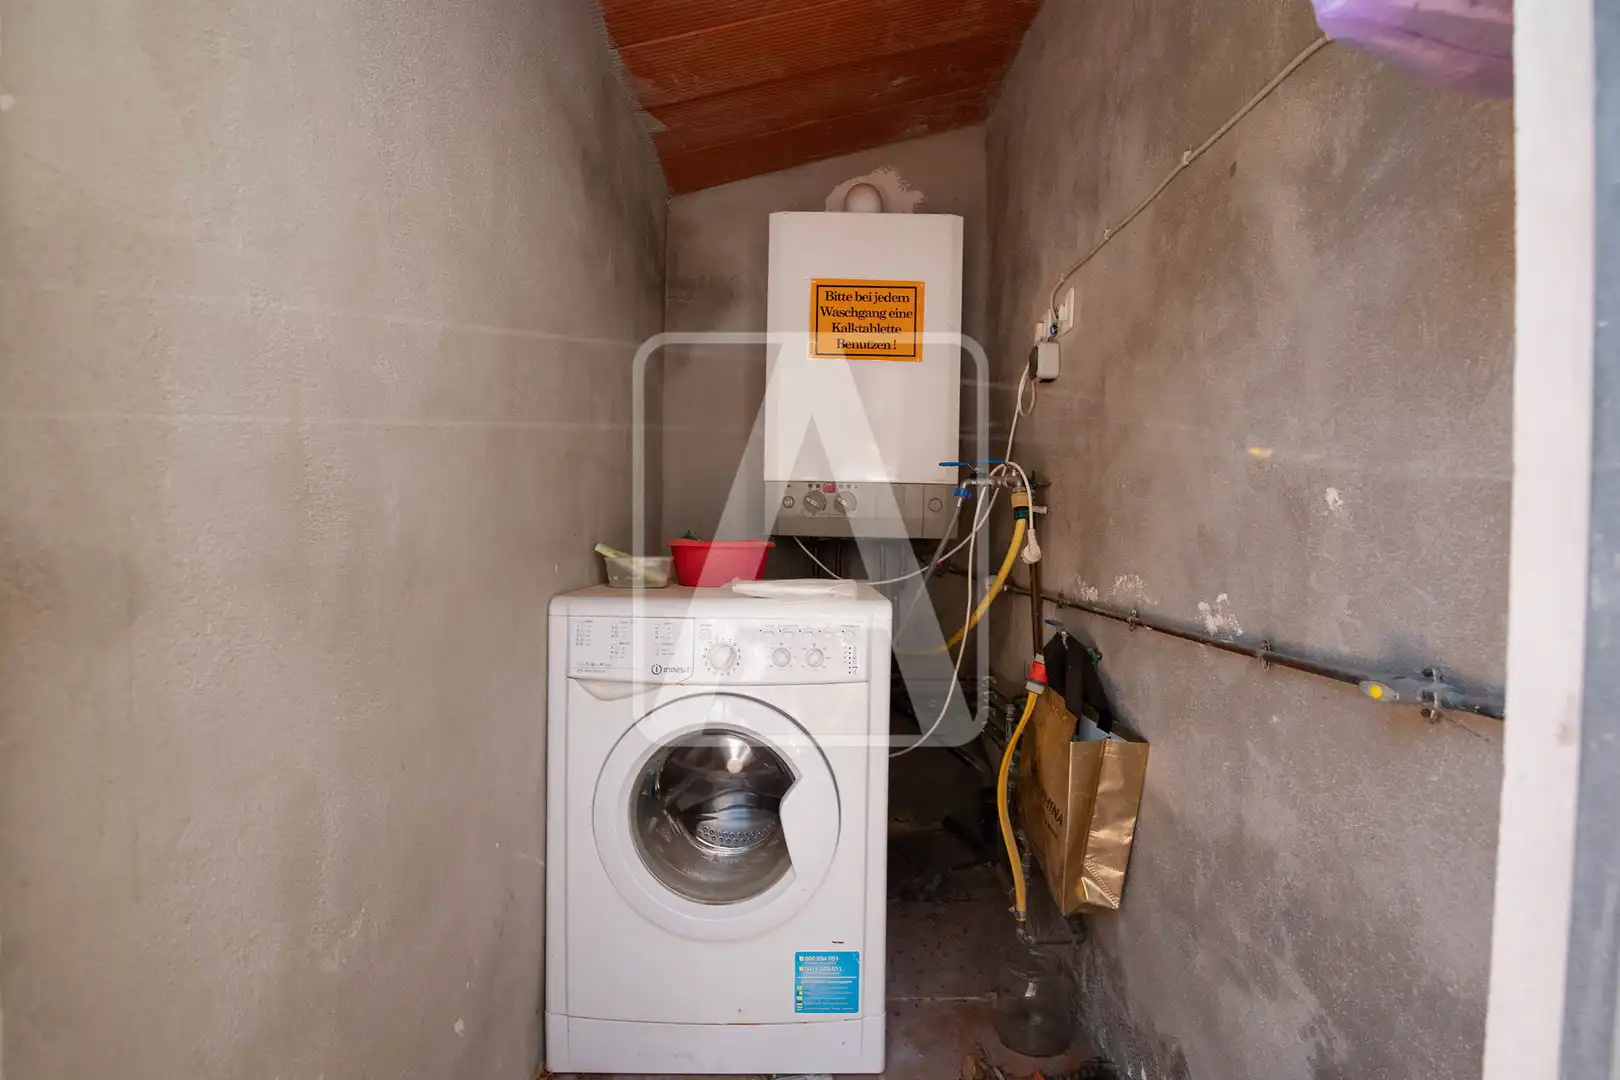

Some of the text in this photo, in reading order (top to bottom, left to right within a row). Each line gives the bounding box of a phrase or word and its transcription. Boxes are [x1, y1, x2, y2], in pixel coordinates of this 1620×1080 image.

[825, 290, 910, 304] Bitte bei jedem
[820, 306, 913, 320] Waschgang eine
[831, 322, 902, 334] Kalktablette
